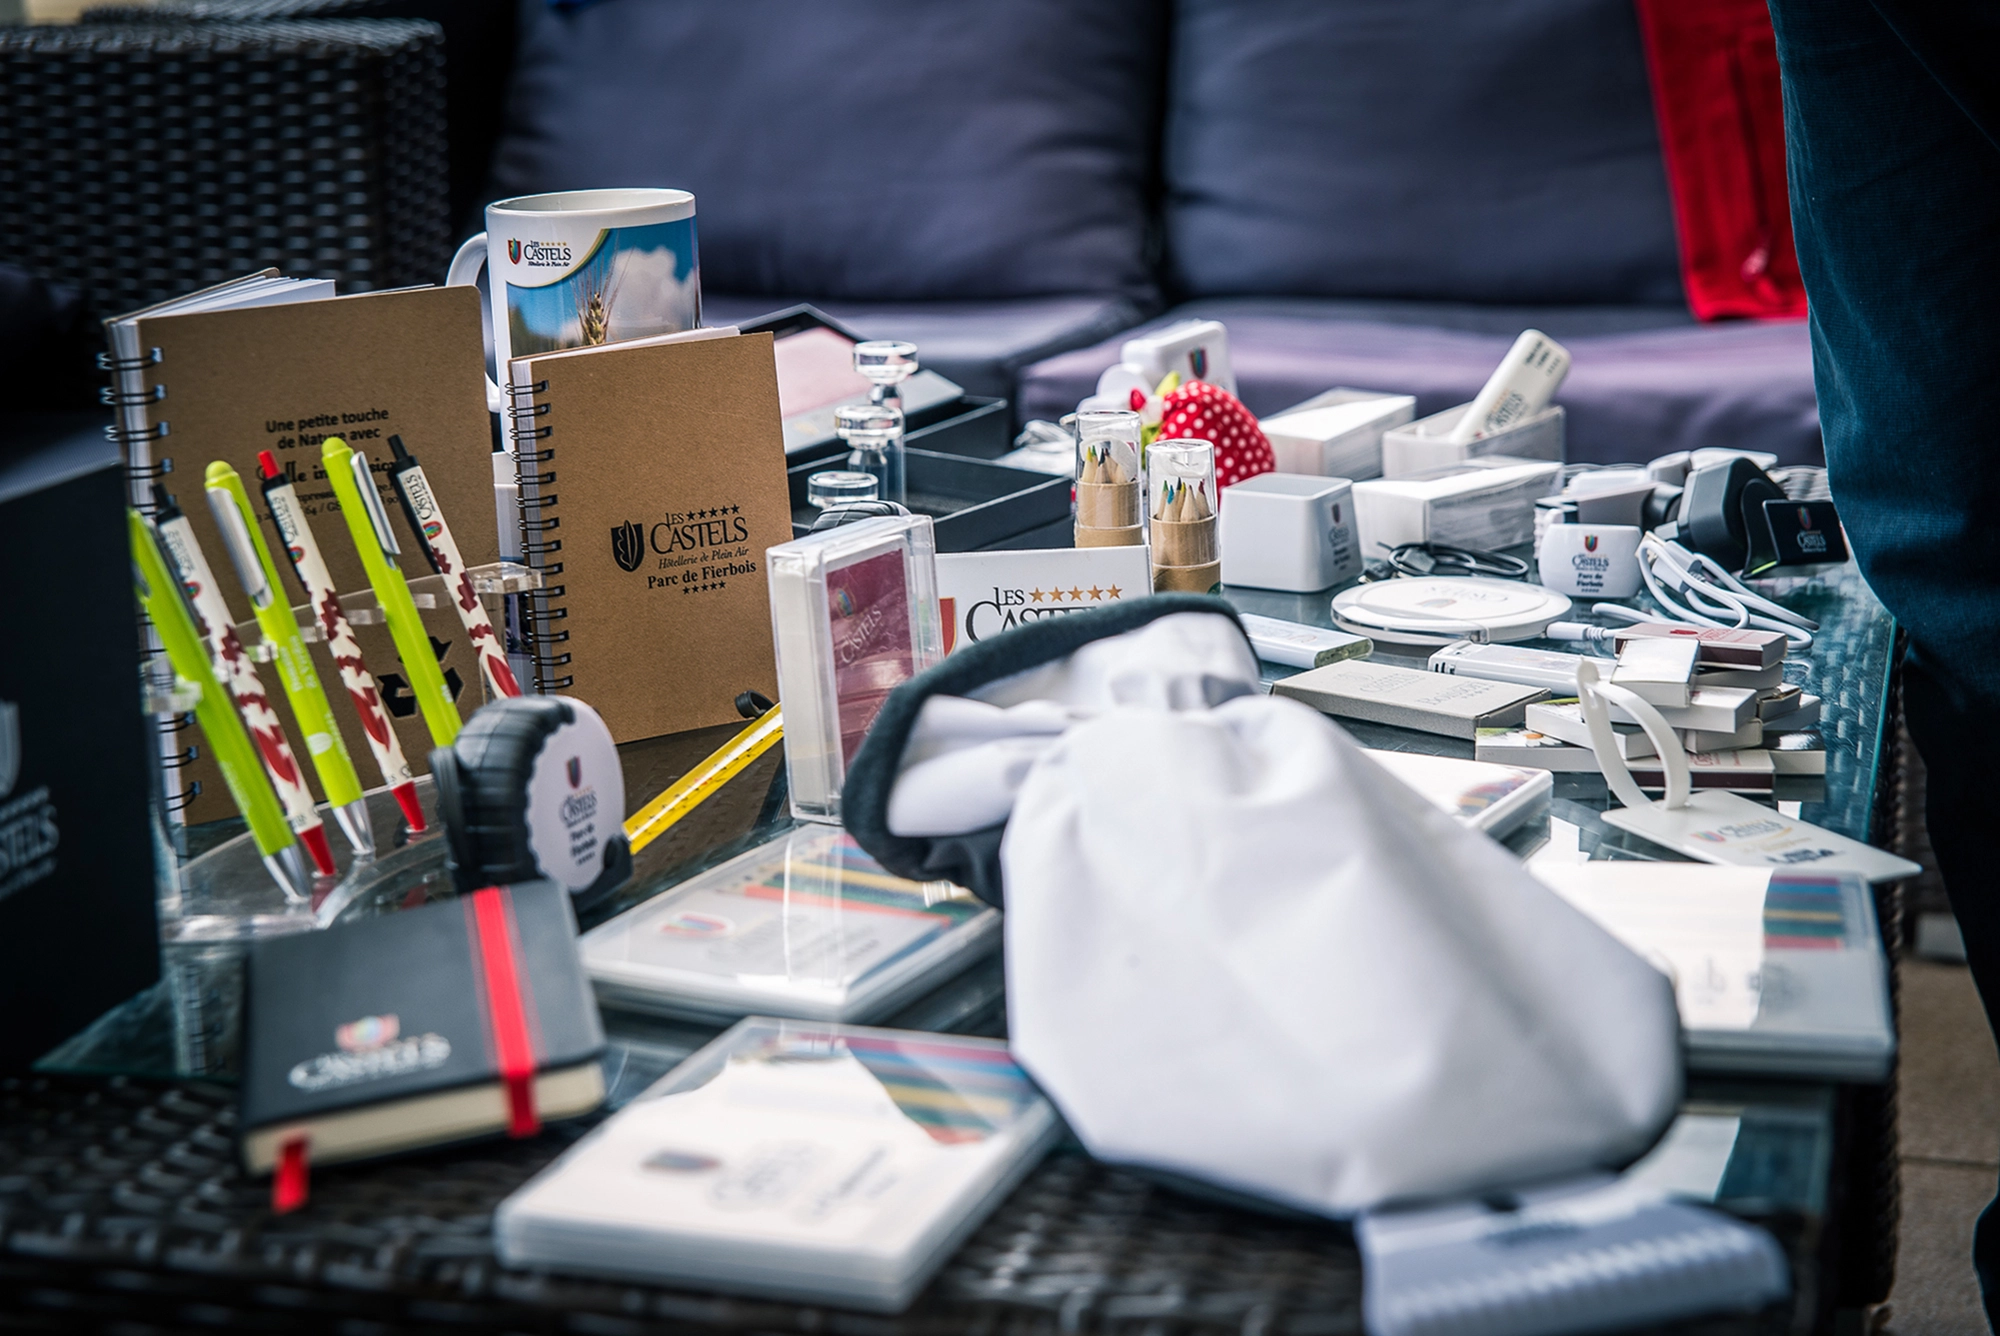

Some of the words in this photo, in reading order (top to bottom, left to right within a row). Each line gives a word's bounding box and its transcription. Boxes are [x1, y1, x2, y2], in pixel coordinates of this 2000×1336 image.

[524, 244, 571, 260] CASTELS
[266, 420, 294, 433] Une
[298, 413, 339, 432] petite
[342, 407, 389, 424] touche
[278, 436, 296, 449] de
[350, 427, 381, 440] avec
[406, 474, 433, 520] CASTELS
[666, 513, 685, 526] LES
[650, 516, 749, 555] CASTELS
[658, 554, 698, 570] Hôtellerie
[700, 552, 709, 562] de
[711, 549, 733, 561] Plein
[734, 547, 749, 557] Air
[647, 575, 679, 589] Parc
[682, 570, 698, 583] de
[702, 560, 757, 580] Fierbois
[993, 587, 1025, 606] LES
